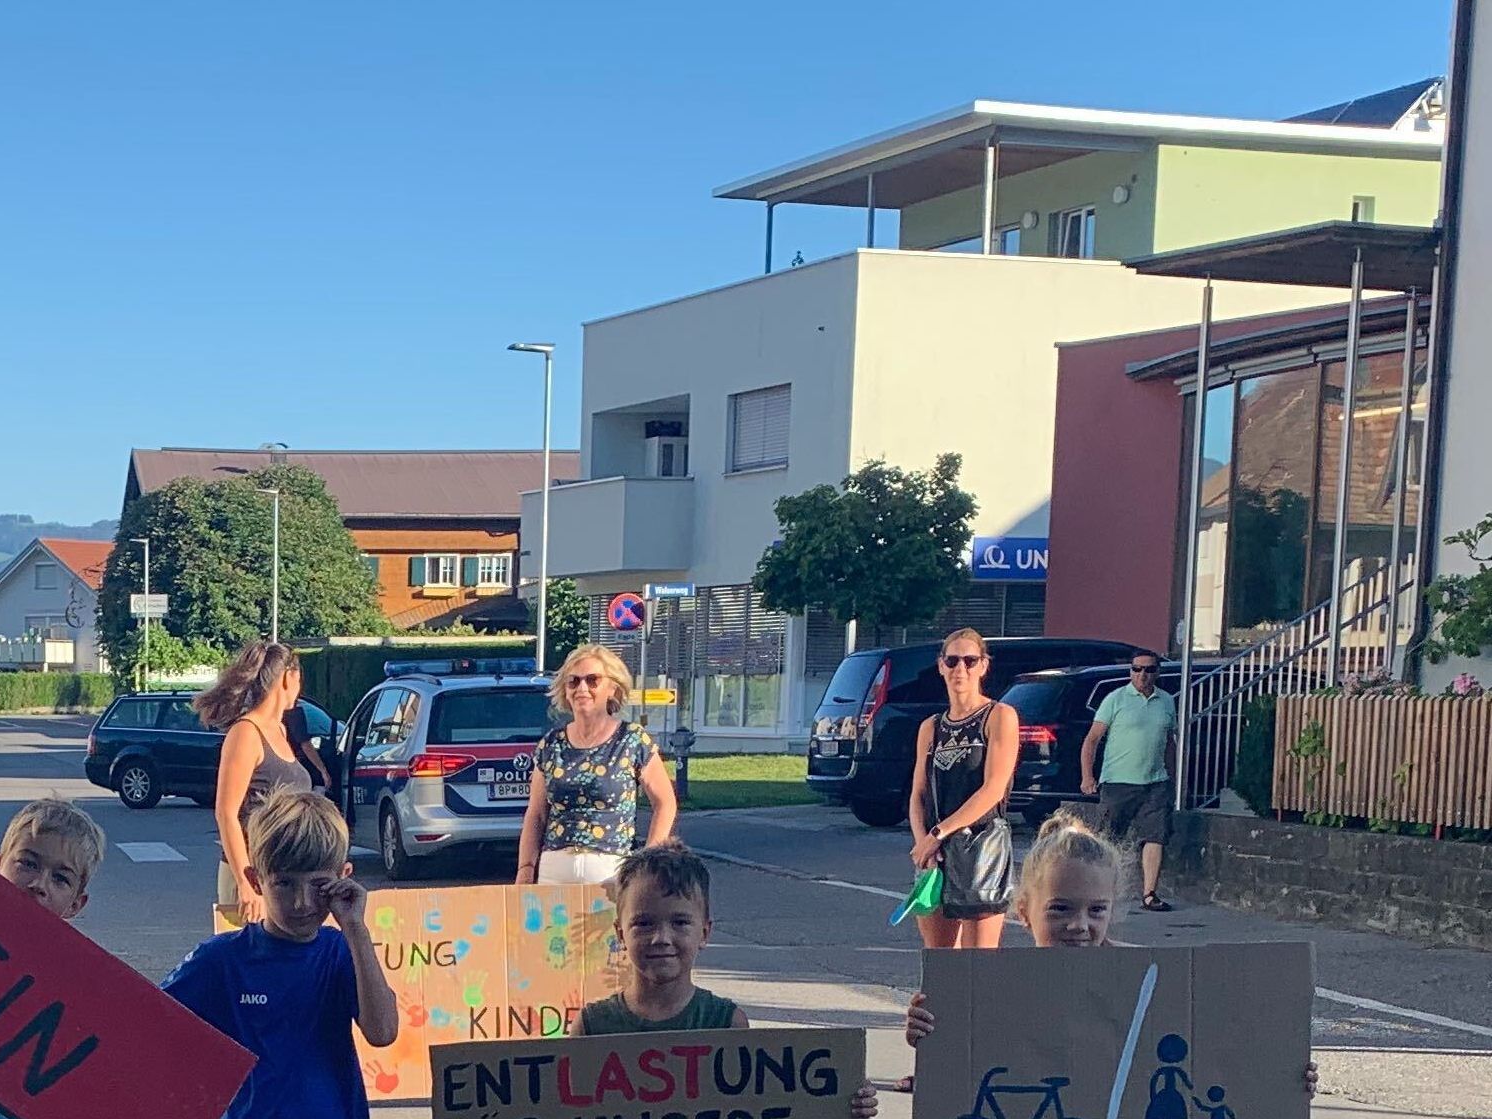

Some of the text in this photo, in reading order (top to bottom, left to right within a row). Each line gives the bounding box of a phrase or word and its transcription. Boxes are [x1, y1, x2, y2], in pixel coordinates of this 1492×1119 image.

[372, 940, 457, 970] UNG
[239, 993, 268, 1005] JAKO
[443, 1045, 839, 1112] ENTLASTUNG
